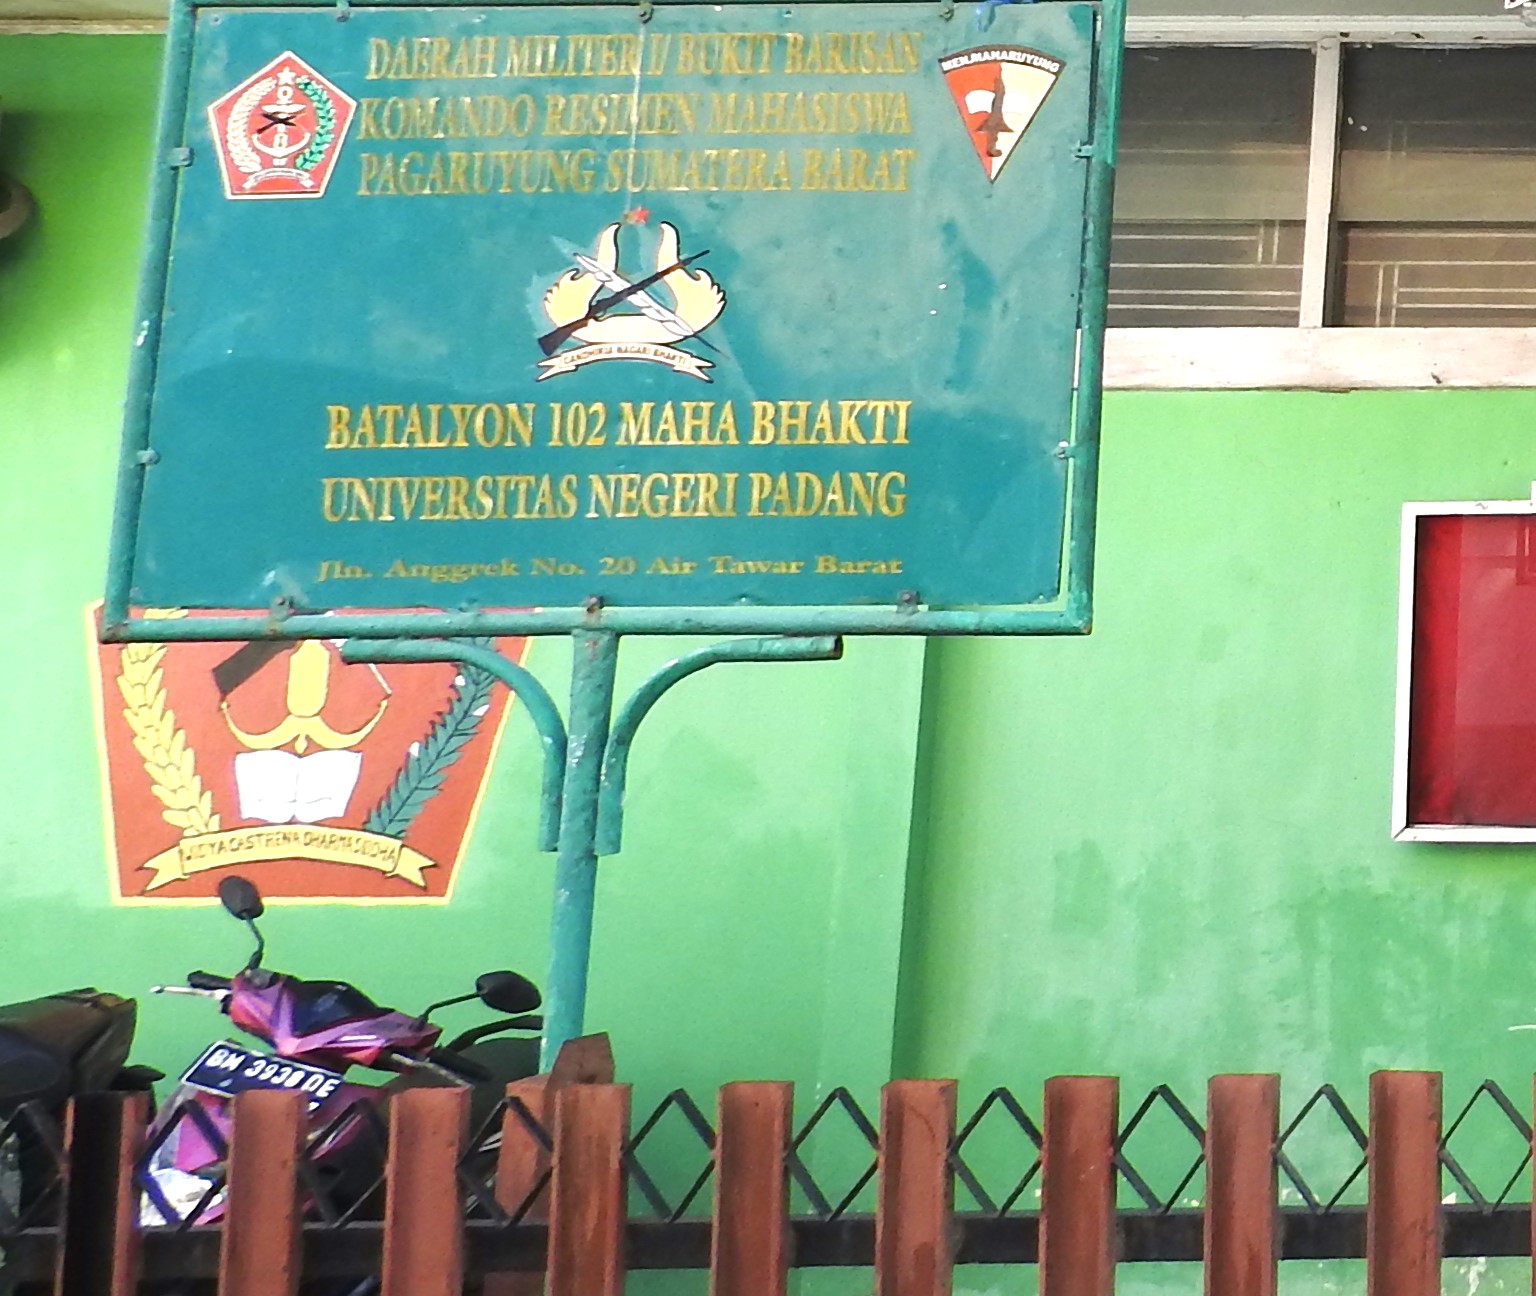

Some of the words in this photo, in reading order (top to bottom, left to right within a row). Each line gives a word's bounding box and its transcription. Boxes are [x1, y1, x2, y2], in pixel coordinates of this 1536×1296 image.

[365, 36, 499, 80] DAERAH
[502, 33, 640, 77] MILITER
[675, 32, 778, 75] BUKIT
[784, 32, 922, 75] BARISAN
[356, 94, 536, 140] KOMANDO
[542, 92, 698, 137] RESIMEN
[705, 91, 911, 134] MAHASISWA
[357, 149, 598, 196] PAGARUYUNG
[605, 148, 791, 193] SUMATERA
[799, 148, 917, 191] BARAT
[324, 402, 536, 449] BATALYON
[547, 401, 607, 448] 102
[615, 400, 740, 446] MAHA
[748, 400, 912, 445] BHAKTI
[321, 473, 578, 522] UNIVERSITAS
[585, 472, 739, 519] NEGERI
[747, 470, 907, 518] PADANG
[384, 558, 520, 584] Anggrek
[530, 558, 586, 576] No.
[597, 556, 638, 576] 20
[646, 556, 697, 575] Air
[708, 555, 805, 575] Tawar
[814, 555, 903, 574] Barat
[205, 1049, 246, 1071] BM
